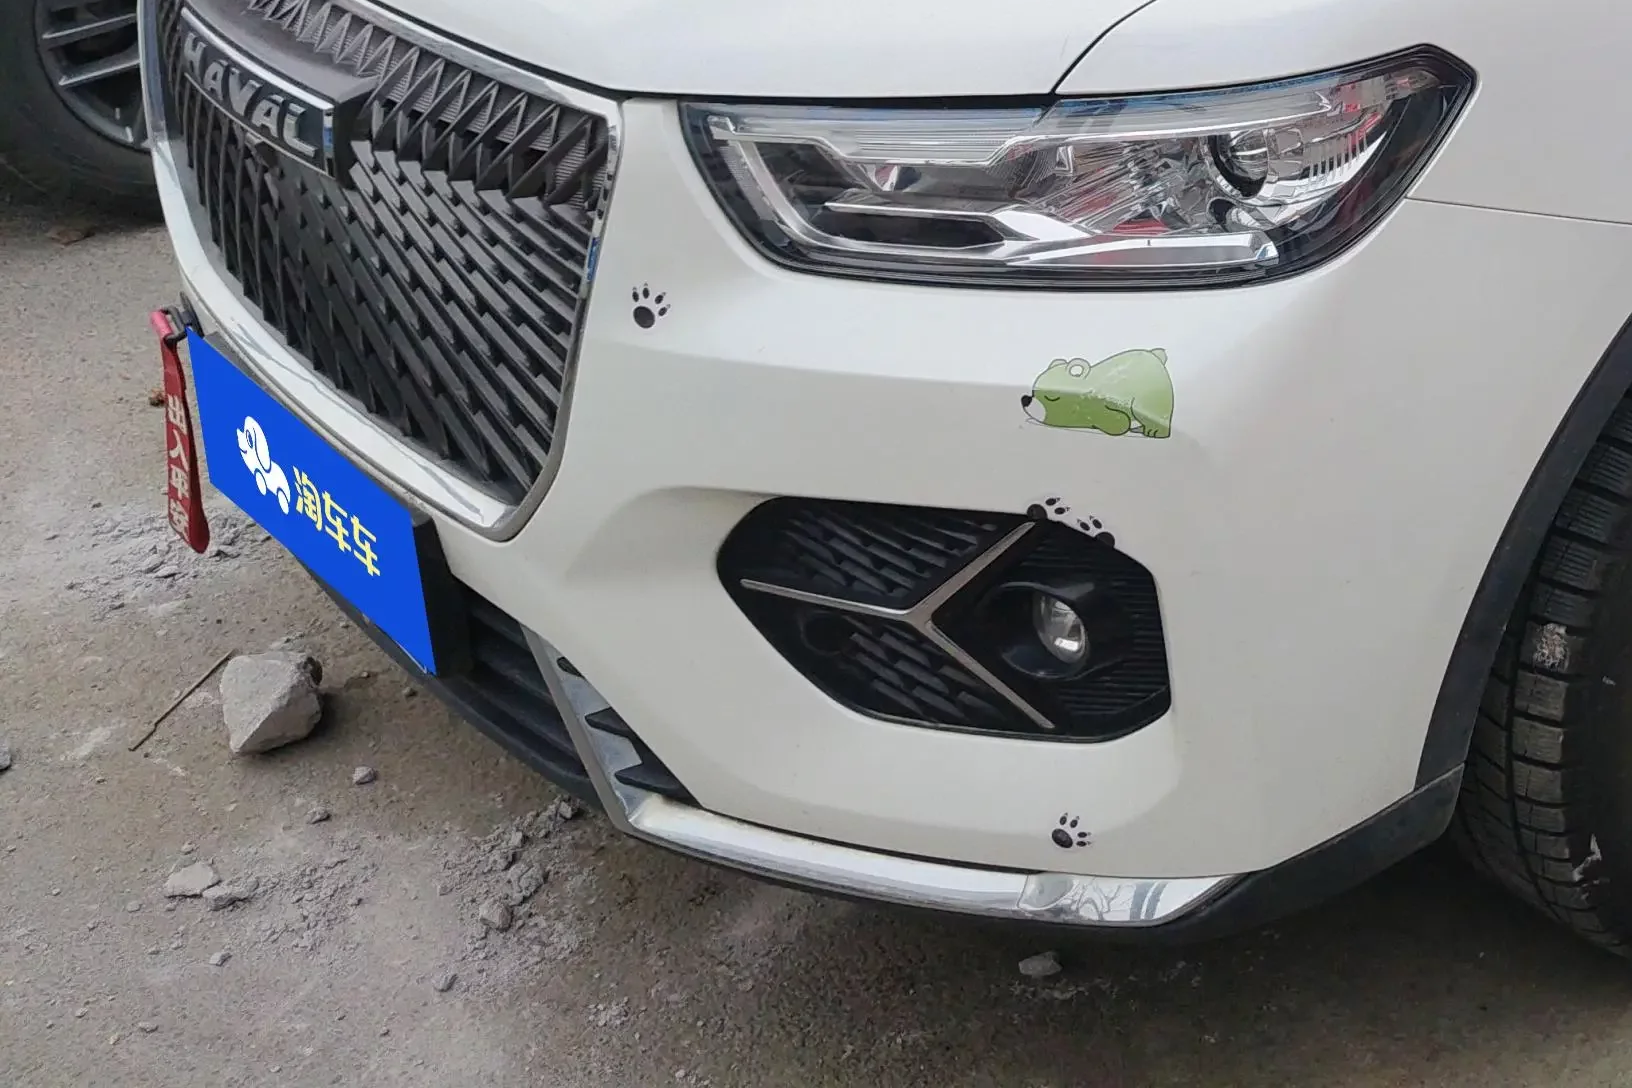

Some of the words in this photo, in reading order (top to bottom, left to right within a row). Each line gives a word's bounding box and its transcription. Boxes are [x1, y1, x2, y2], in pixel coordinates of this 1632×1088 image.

[183, 31, 319, 159] HAVAL
[166, 392, 190, 542] 出入平安
